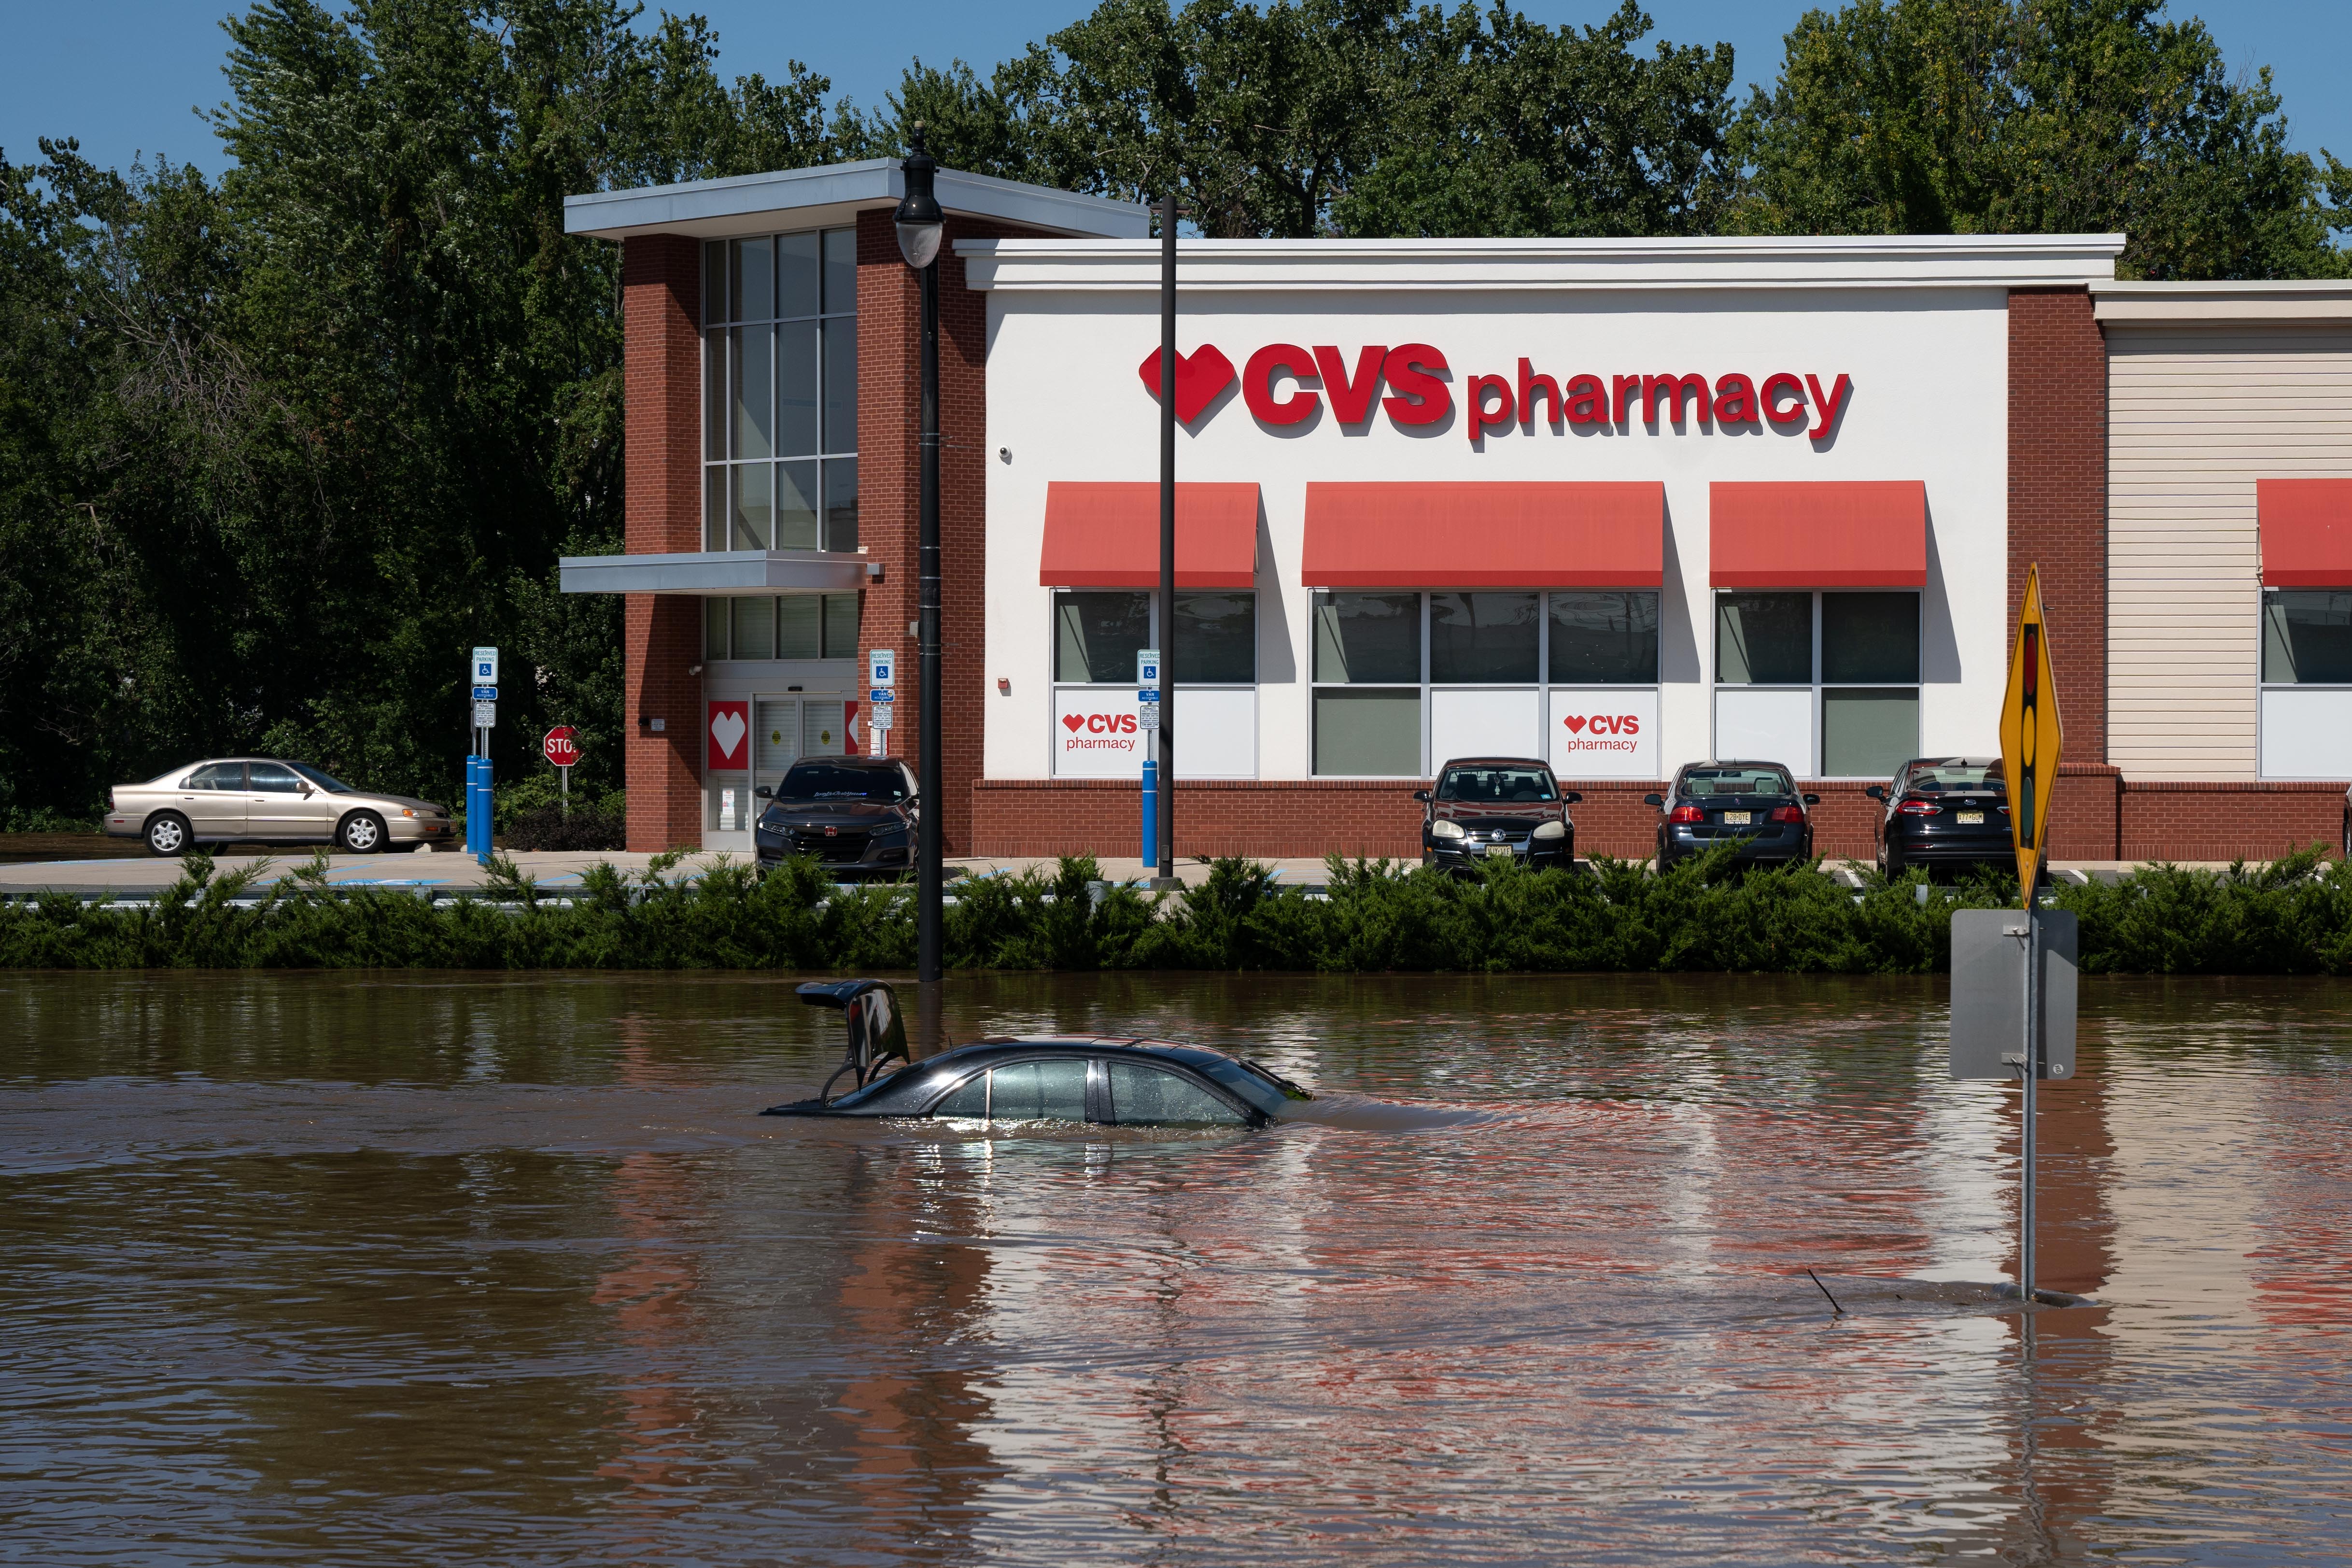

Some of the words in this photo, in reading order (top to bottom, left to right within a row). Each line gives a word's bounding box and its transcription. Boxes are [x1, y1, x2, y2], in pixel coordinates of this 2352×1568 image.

[1242, 343, 1449, 425] CVS
[1468, 357, 1849, 439] pharmacy
[1087, 714, 1137, 733] CVS
[1589, 715, 1639, 735] CVS
[547, 739, 576, 753] STO
[1067, 737, 1135, 751] pharmacy
[1568, 738, 1637, 752] pharmacy
